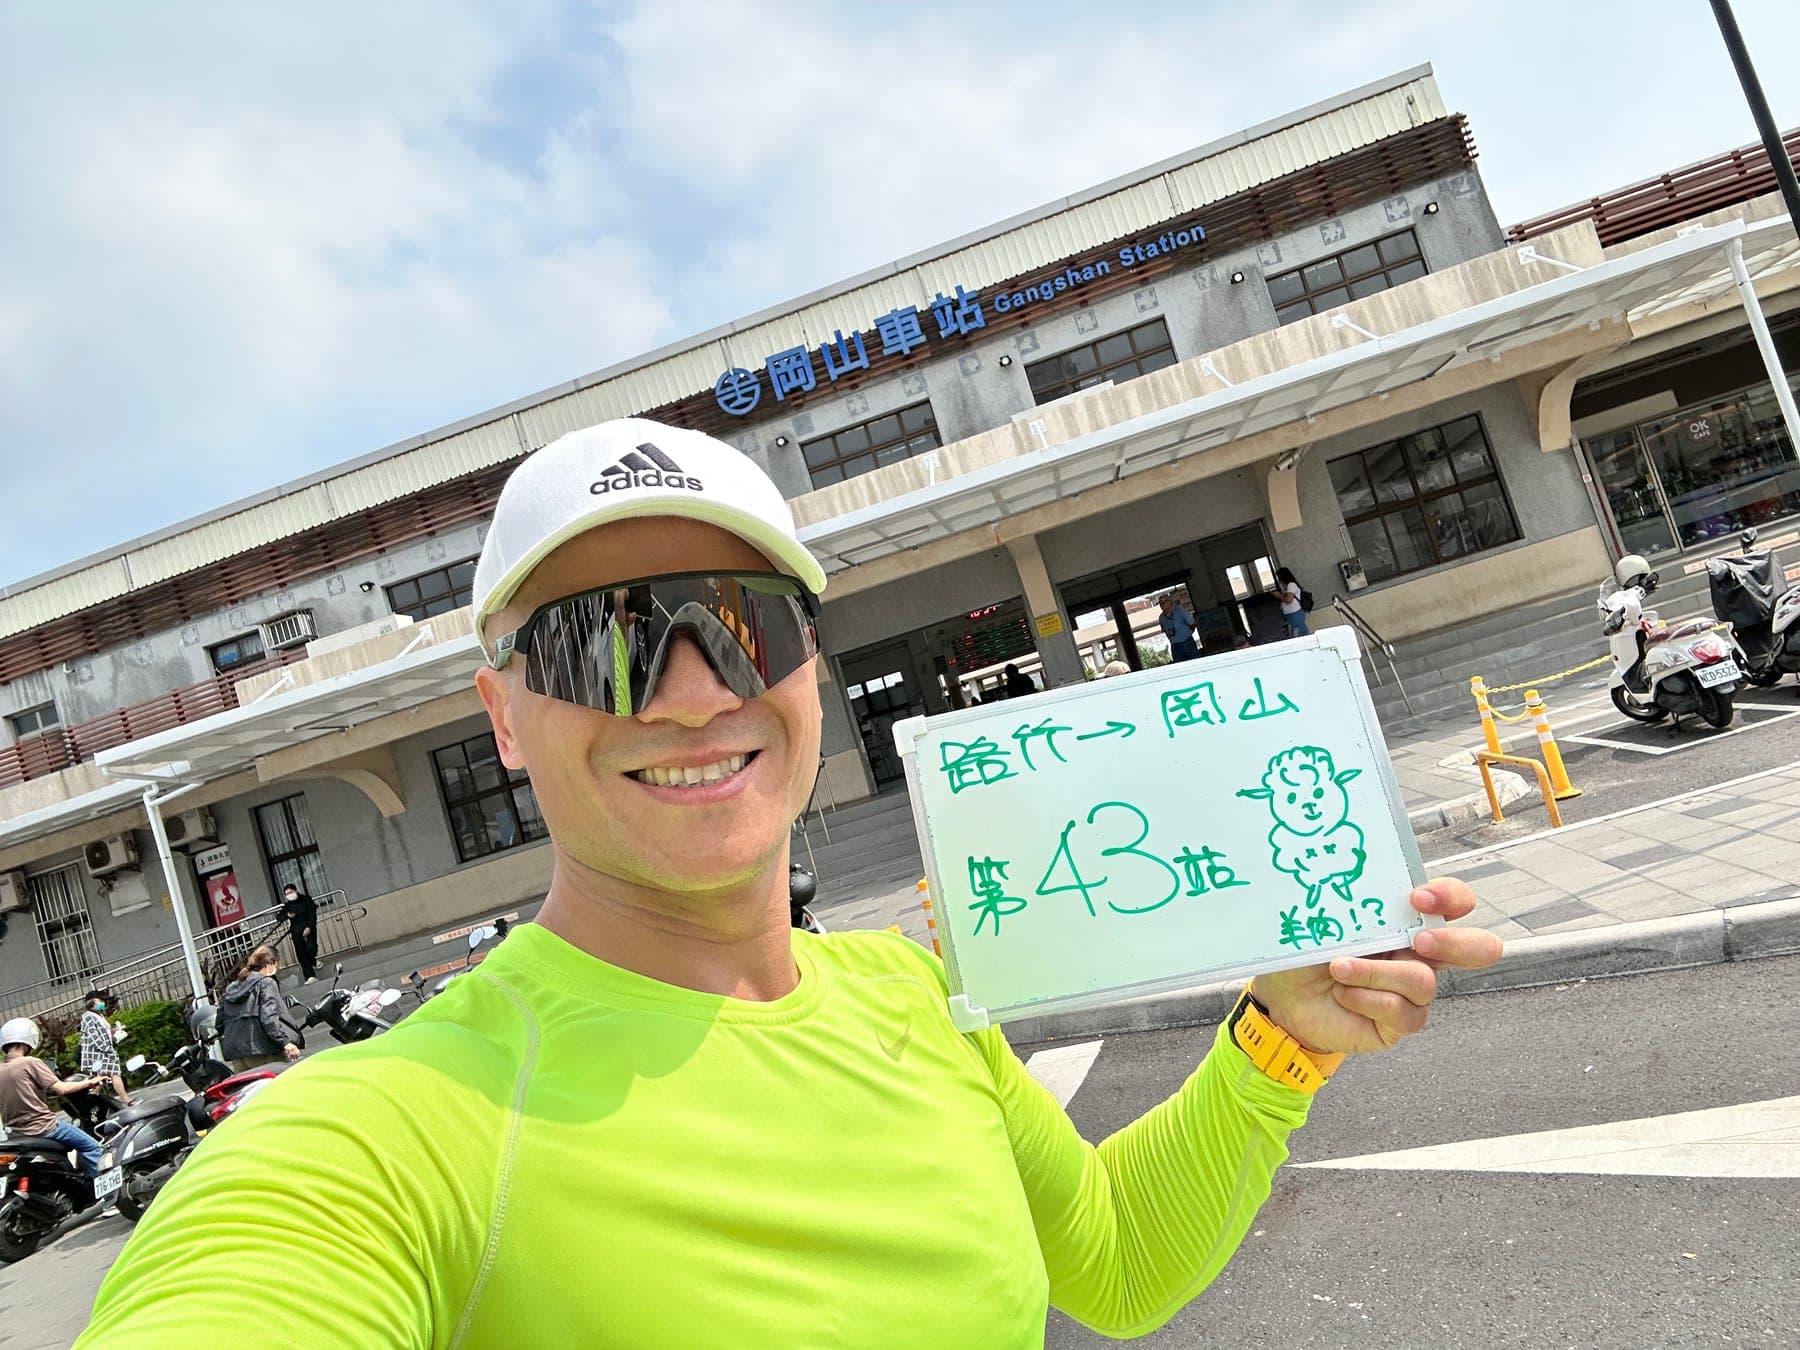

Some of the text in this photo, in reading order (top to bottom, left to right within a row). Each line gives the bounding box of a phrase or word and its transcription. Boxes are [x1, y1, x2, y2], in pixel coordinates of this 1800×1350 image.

[994, 224, 1206, 313] Gangshan Station
[766, 285, 986, 399] 岡山車站
[1690, 420, 1709, 433] OK
[590, 470, 703, 494] adidas
[1161, 679, 1300, 739] 岡山
